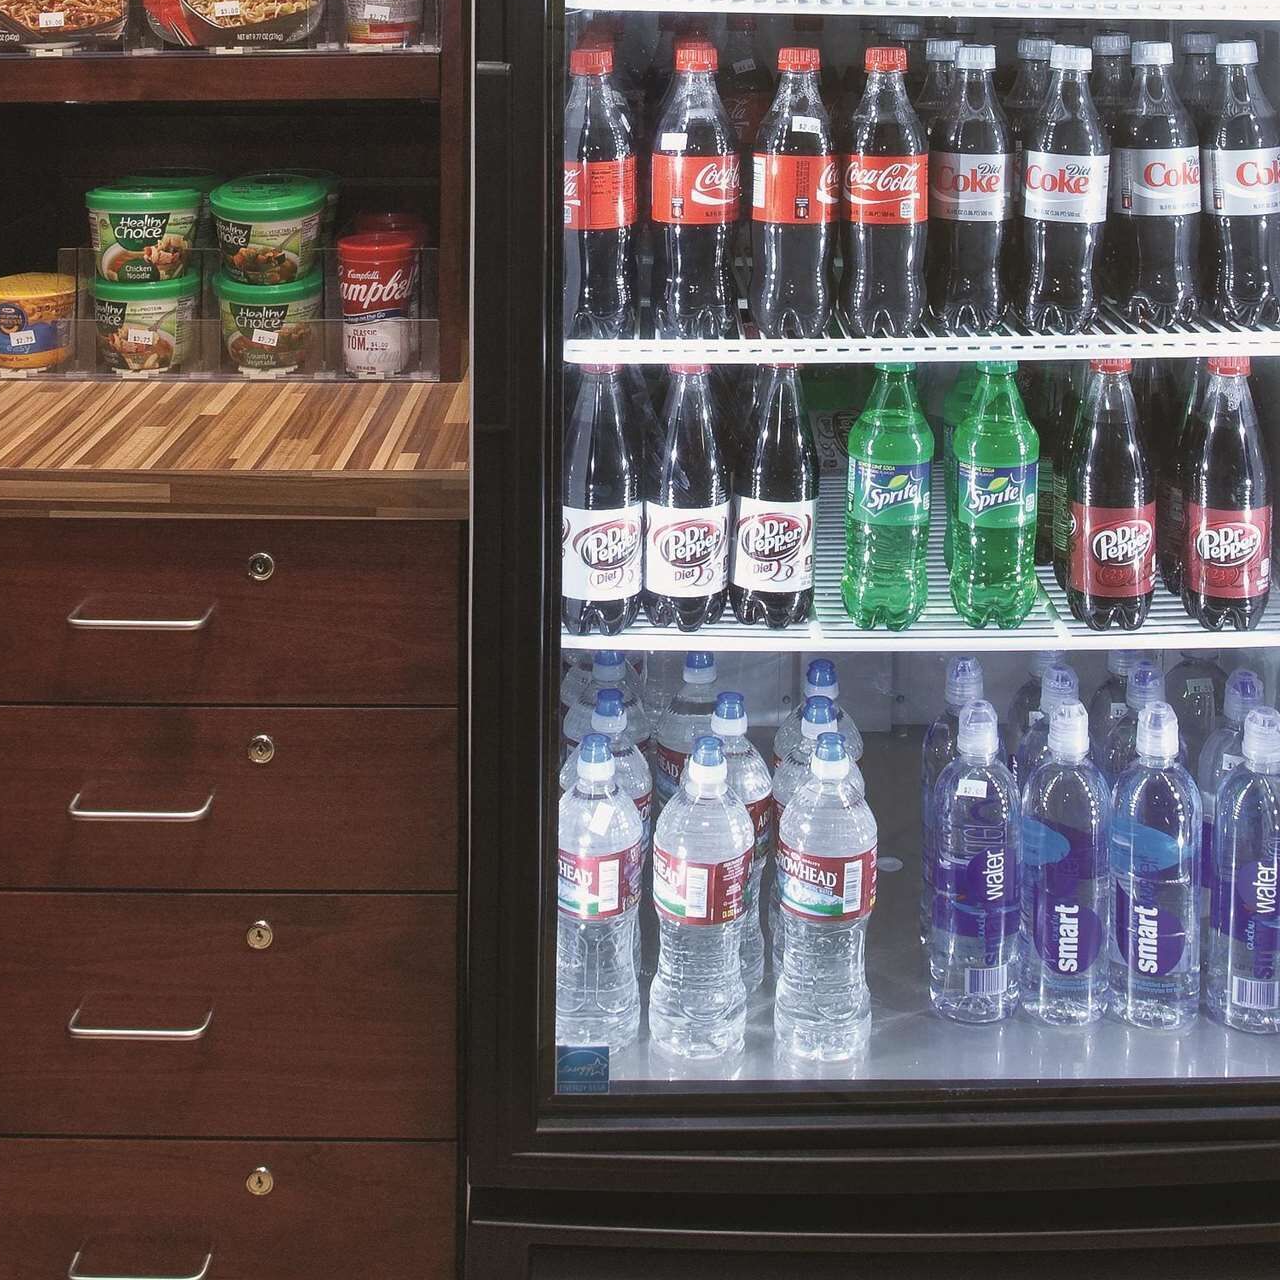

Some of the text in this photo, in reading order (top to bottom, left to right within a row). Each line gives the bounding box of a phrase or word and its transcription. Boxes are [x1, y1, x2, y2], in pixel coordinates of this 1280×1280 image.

[937, 166, 1000, 193] Coke
[1027, 165, 1089, 193] Coke
[1144, 161, 1200, 186] Coke
[114, 226, 162, 239] Choice
[120, 216, 166, 230] Healthy
[239, 308, 284, 319] Healthy
[868, 483, 919, 509] Sprite
[967, 485, 1018, 511] Sprite
[596, 571, 617, 585] Diet
[675, 568, 694, 581] Diet
[1057, 904, 1079, 972] smart
[1138, 904, 1159, 974] smart
